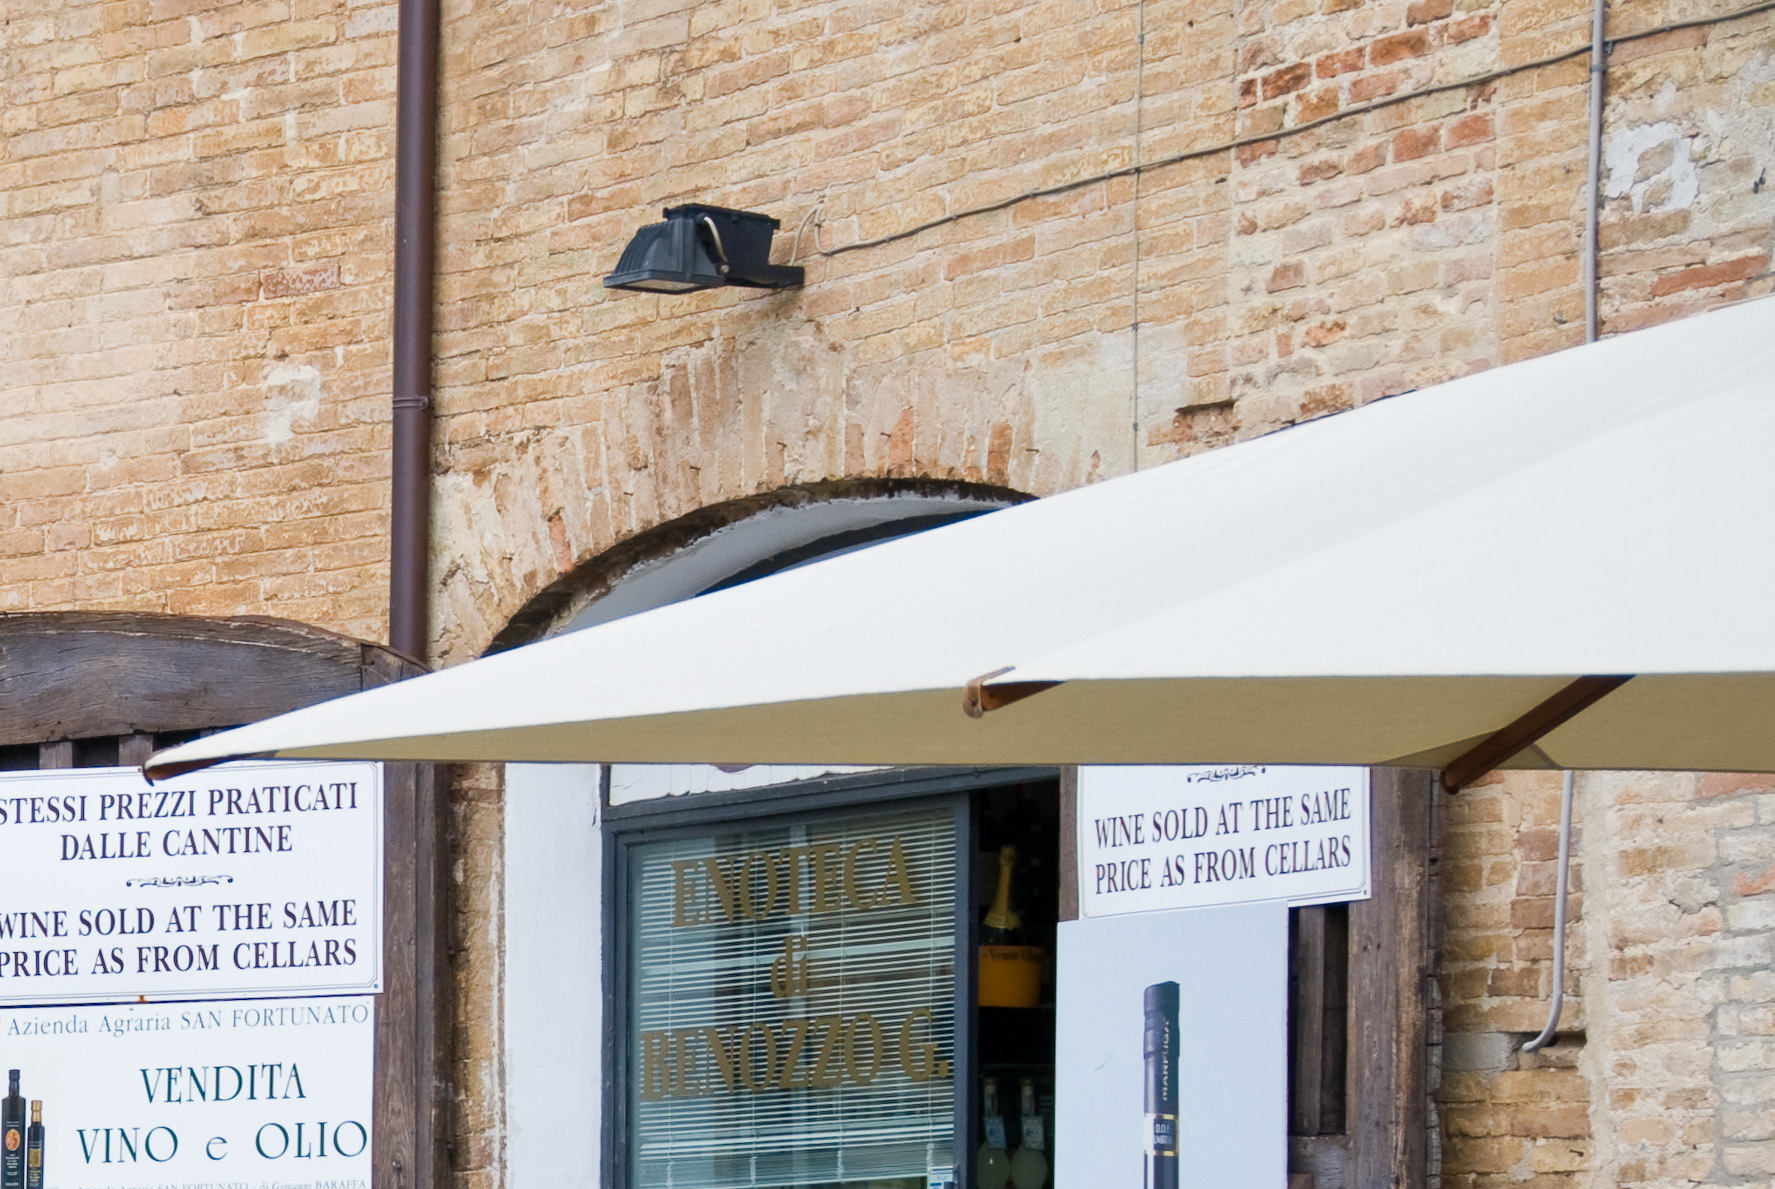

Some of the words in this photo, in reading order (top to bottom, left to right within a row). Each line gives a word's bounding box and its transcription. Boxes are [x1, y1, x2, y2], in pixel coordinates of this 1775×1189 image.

[98, 789, 196, 822] PREZZI
[207, 781, 360, 818] PRATICATI
[1094, 812, 1145, 850] WINE
[1151, 806, 1209, 844] SOLD
[1214, 801, 1243, 836] AT
[1249, 795, 1294, 833] THE
[1299, 787, 1352, 827] SAME
[59, 831, 152, 862] DALLE
[161, 824, 294, 858] CANTINE
[1095, 858, 1153, 896] PRICE
[1159, 854, 1186, 888] AS
[1193, 846, 1257, 885] FROM
[1264, 834, 1352, 877] CELLARS
[670, 834, 918, 928] ENOTECA
[78, 906, 156, 937] SOLD
[164, 905, 203, 935] AT
[211, 901, 273, 933] THE
[281, 898, 358, 930] SAME
[90, 946, 126, 977] AS
[136, 943, 220, 975] FROM
[232, 938, 358, 970] CELLARS
[769, 934, 811, 1000] di
[7, 1014, 89, 1037] Azienda
[97, 1011, 172, 1039] Agraria
[180, 1009, 225, 1031] SAN
[232, 1002, 369, 1029] FORTUNATO
[639, 1010, 884, 1101] BENOZZO
[898, 1006, 950, 1082] G.
[139, 1061, 307, 1106] VENDITA
[75, 1125, 180, 1165] VINO
[204, 1135, 228, 1162] e
[254, 1120, 369, 1161] OLIO
